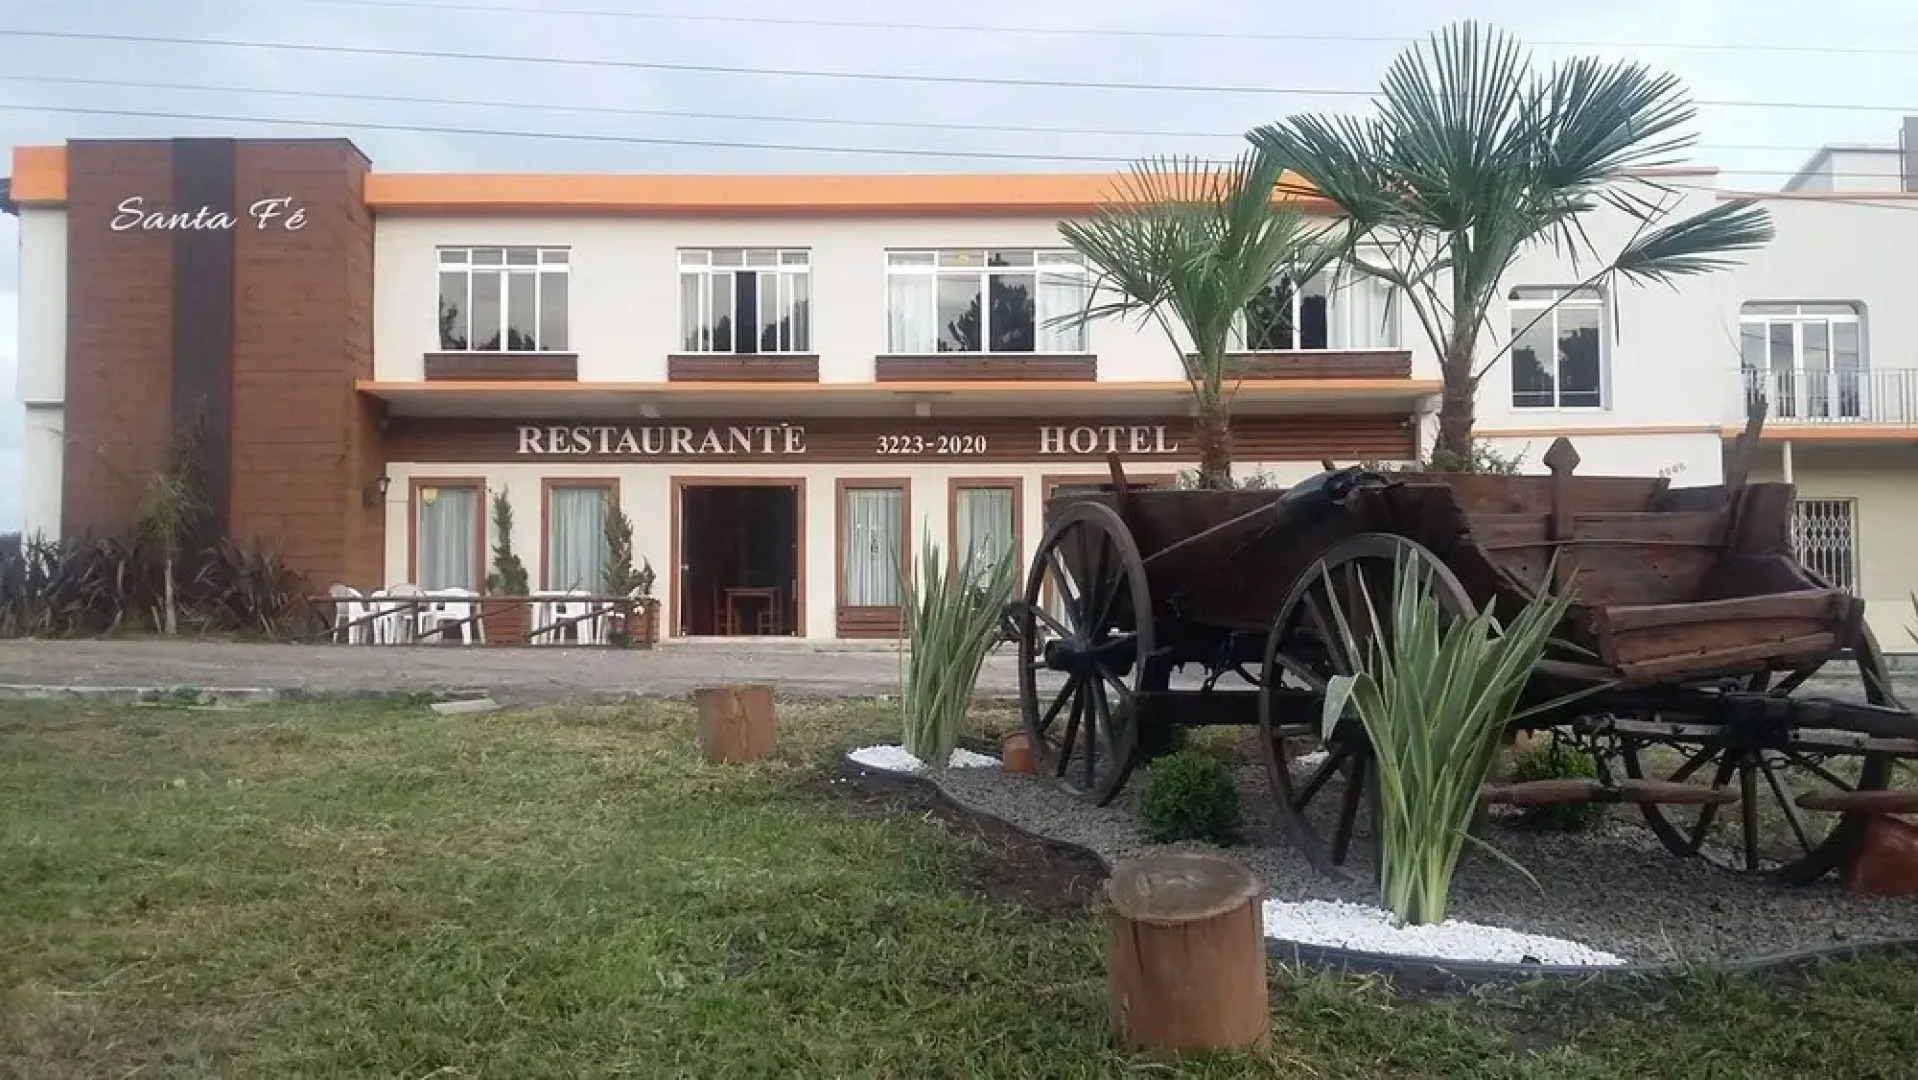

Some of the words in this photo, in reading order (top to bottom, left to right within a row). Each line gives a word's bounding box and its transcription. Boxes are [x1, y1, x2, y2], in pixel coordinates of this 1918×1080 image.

[110, 195, 238, 231] Santa
[249, 196, 308, 231] Fé
[516, 424, 807, 454] RESTAURANTE
[875, 434, 987, 454] 3223-2020
[1037, 425, 1179, 454] HOTEL
